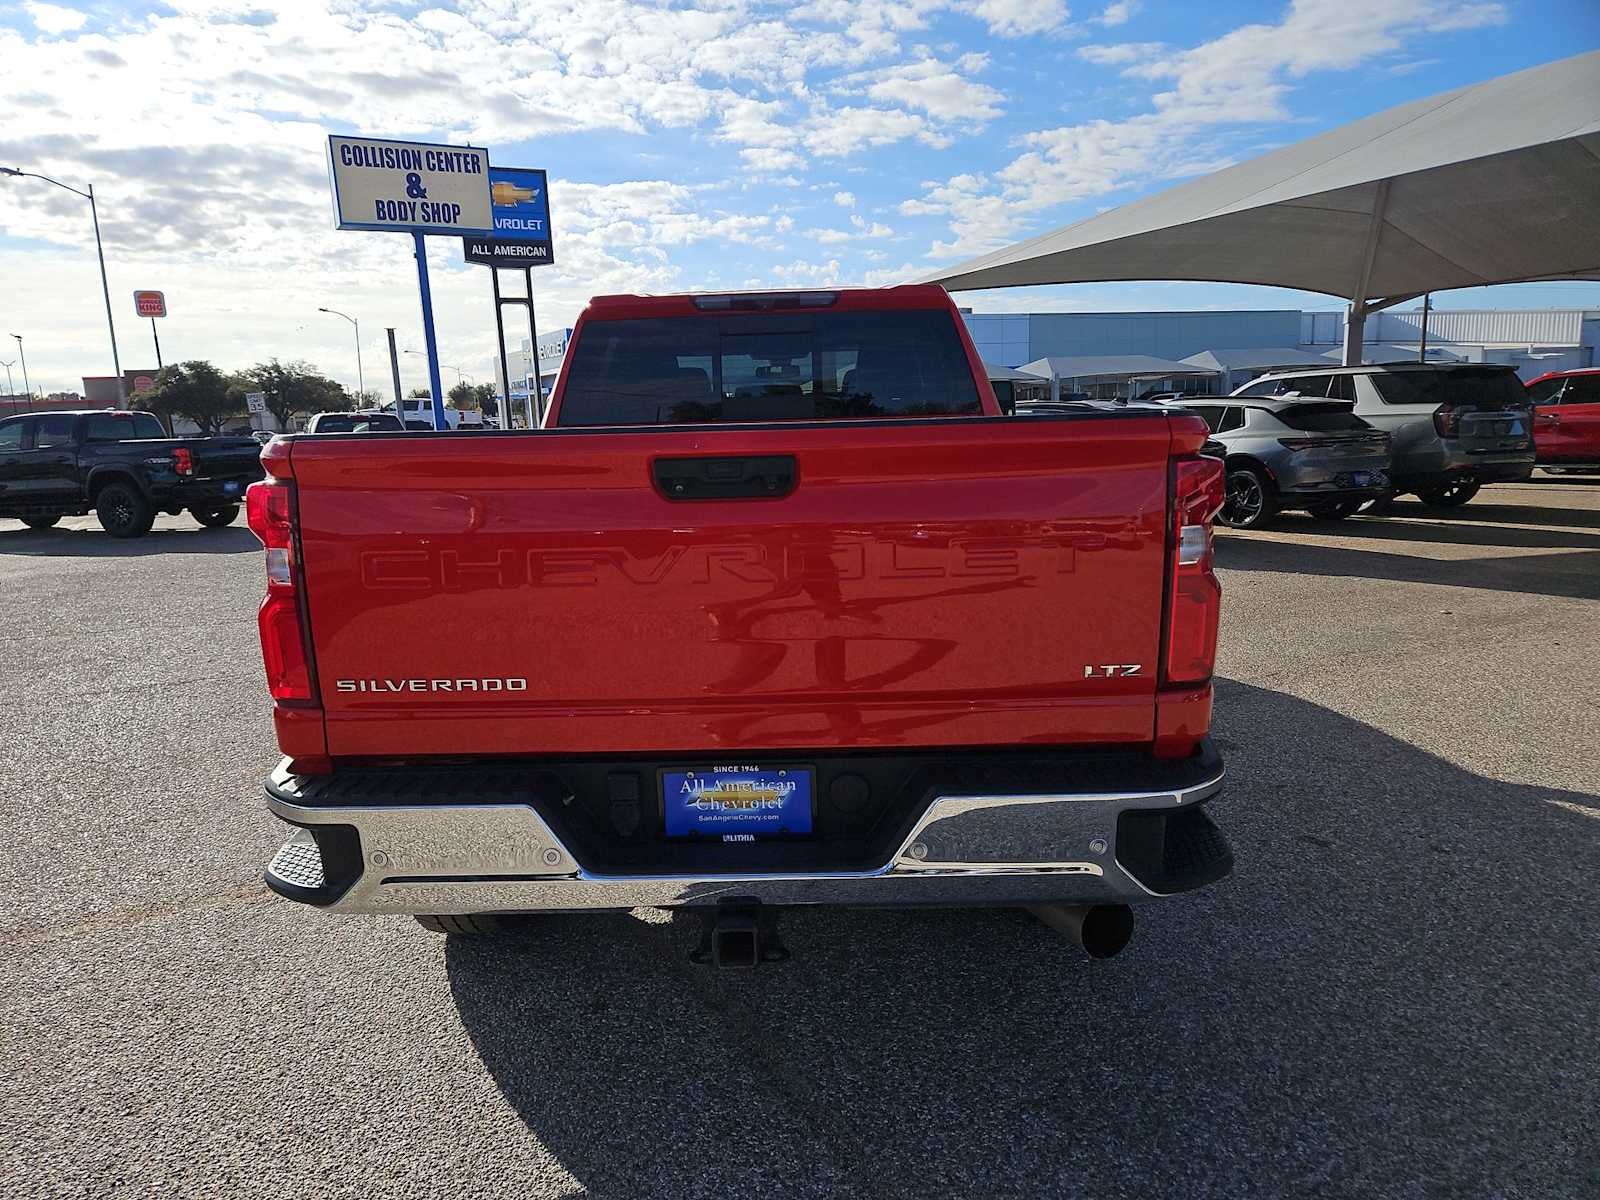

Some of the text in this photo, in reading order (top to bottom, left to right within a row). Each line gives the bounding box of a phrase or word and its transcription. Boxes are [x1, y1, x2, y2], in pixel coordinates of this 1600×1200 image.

[340, 143, 481, 174] COLLISION CENTER
[406, 172, 427, 199] &
[375, 199, 461, 224] BODY SHOP
[494, 217, 543, 231] VROLET
[471, 244, 547, 257] ALL AMERICAN
[139, 303, 163, 313] KING
[250, 403, 264, 411] 35
[360, 535, 1115, 589] CHEVROLET
[1084, 664, 1143, 678] LTZ
[336, 678, 528, 692] SILVERADO
[680, 778, 797, 793] All American
[696, 796, 783, 810] Chevrolet
[730, 834, 755, 842] LITHIA
